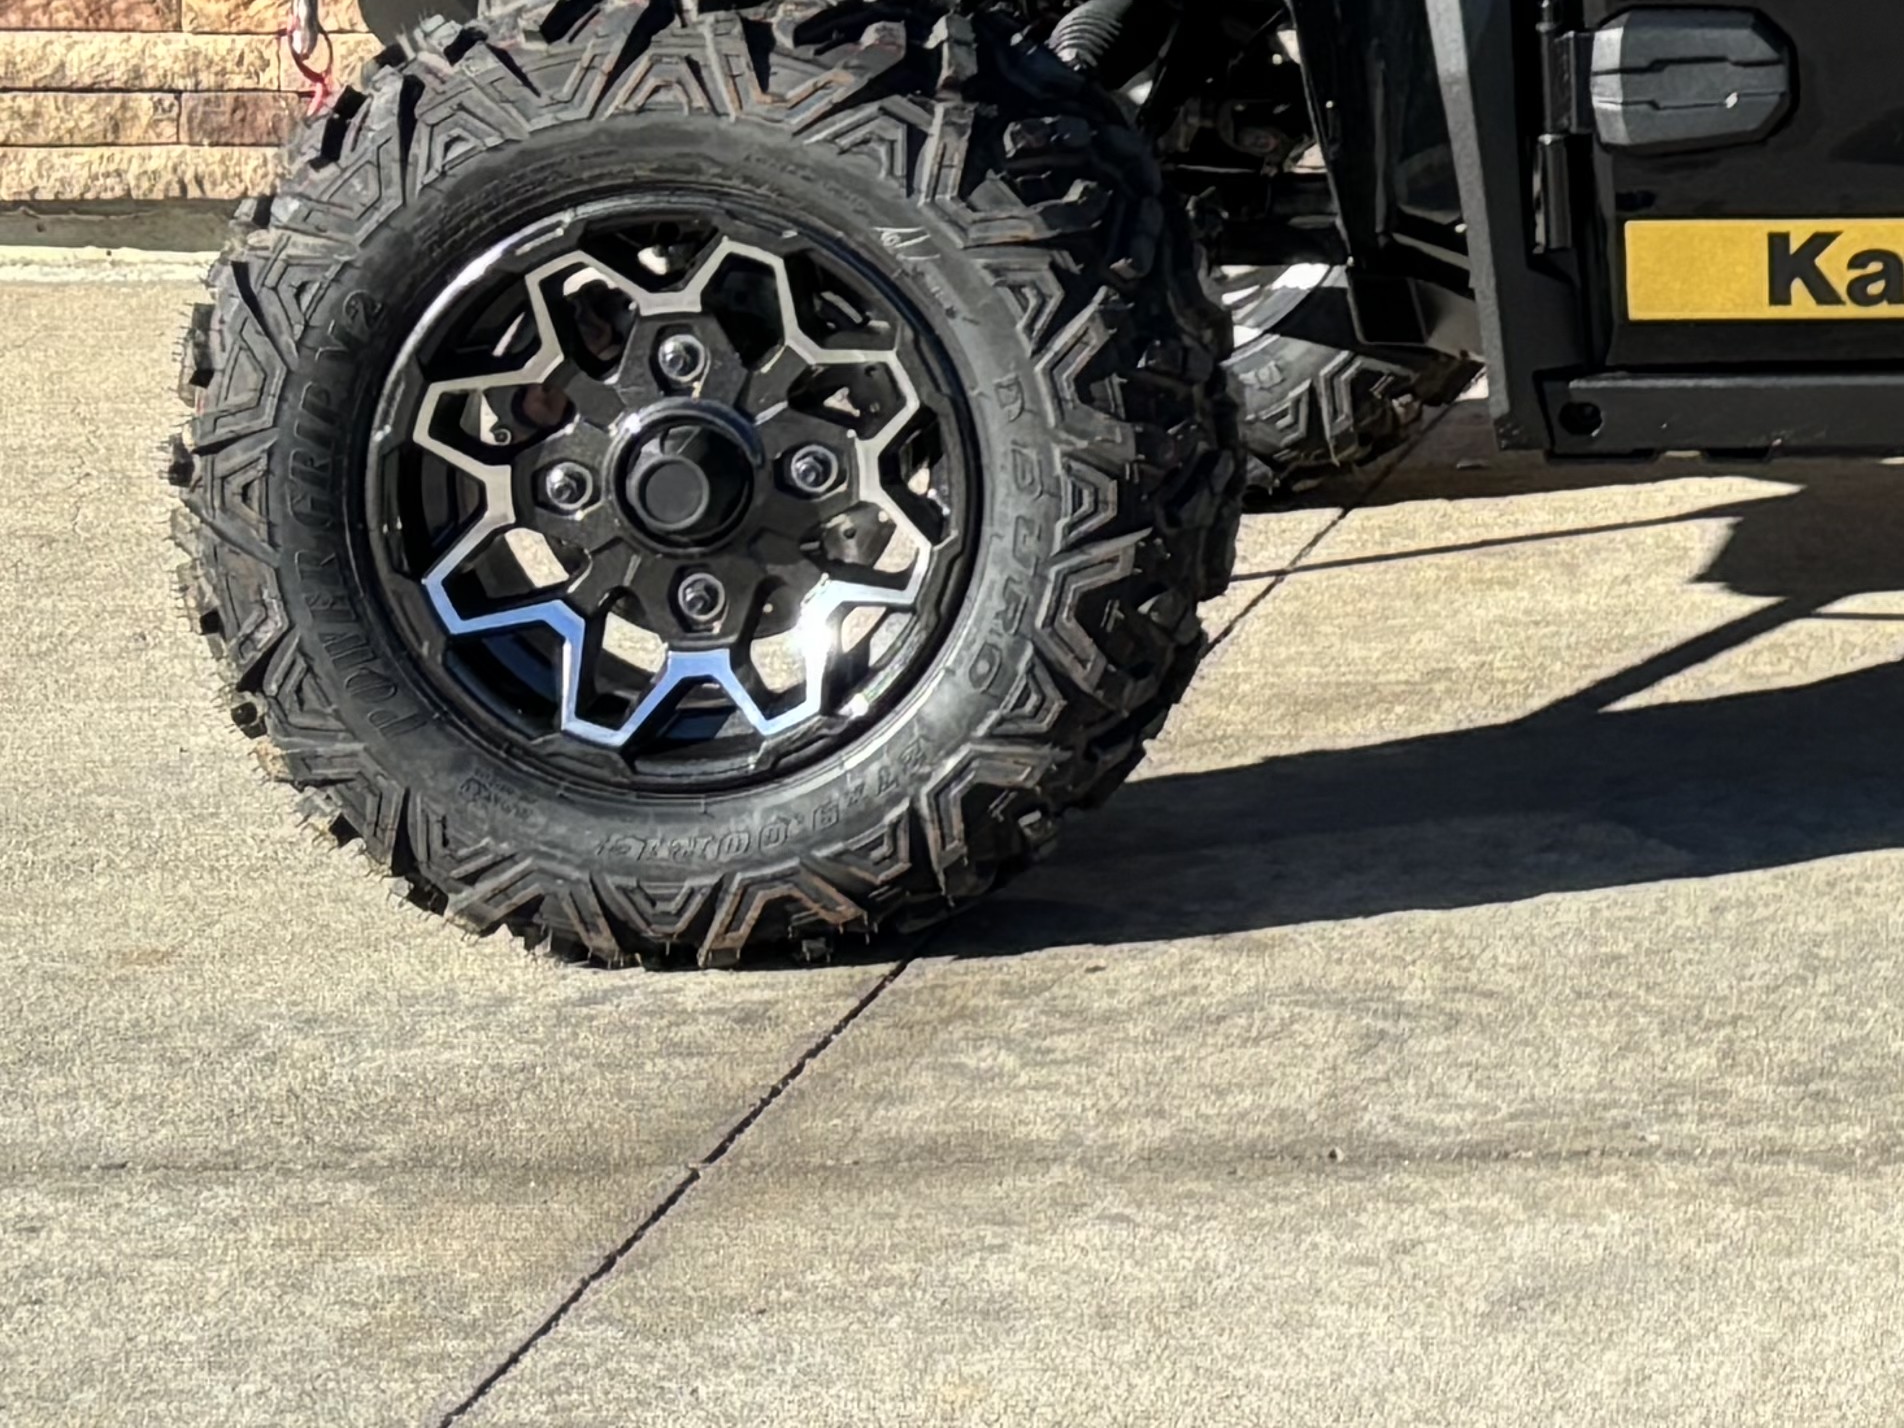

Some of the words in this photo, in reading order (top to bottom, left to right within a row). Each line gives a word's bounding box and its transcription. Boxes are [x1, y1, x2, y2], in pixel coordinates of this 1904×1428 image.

[313, 287, 388, 364] V2
[286, 378, 343, 530] GRIP
[294, 548, 430, 742] POWER
[967, 444, 1044, 692] DURO
